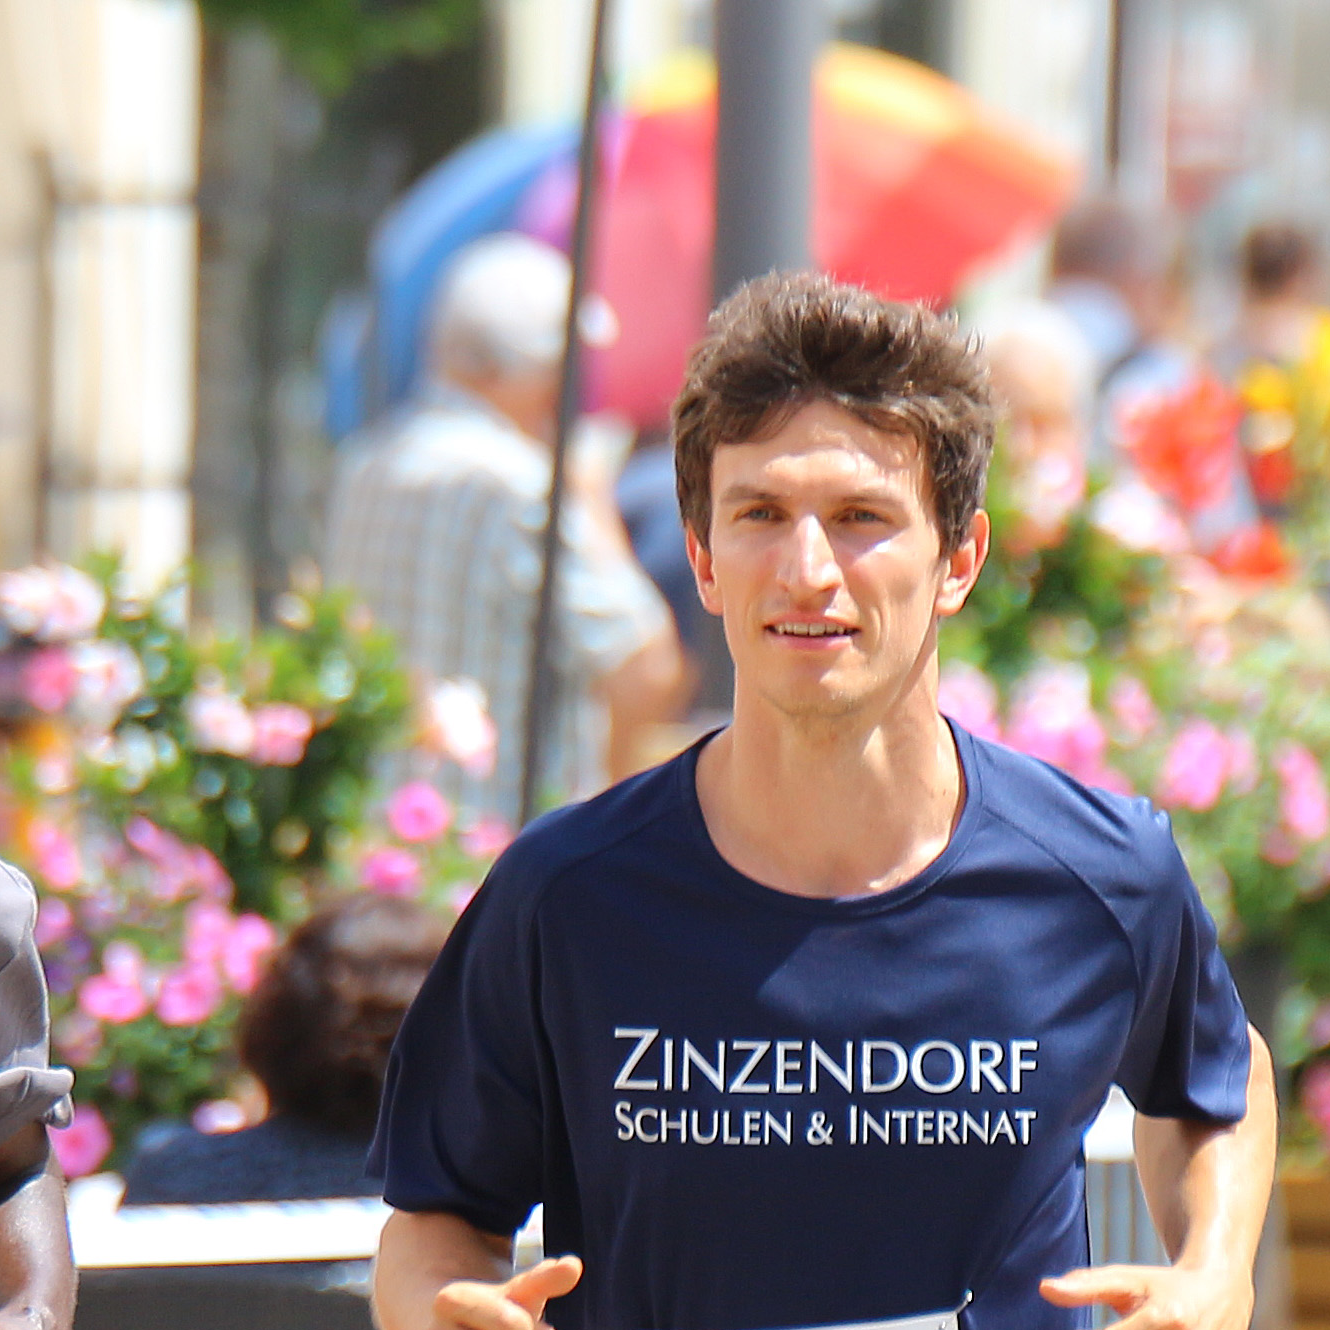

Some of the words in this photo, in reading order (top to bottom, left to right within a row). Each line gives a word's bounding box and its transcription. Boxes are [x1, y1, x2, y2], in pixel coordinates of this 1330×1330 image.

[614, 1027, 1038, 1094] ZINZENDORF
[614, 1101, 794, 1146] SCHULEN
[806, 1111, 834, 1145] &
[850, 1104, 1037, 1146] INTERNAT
